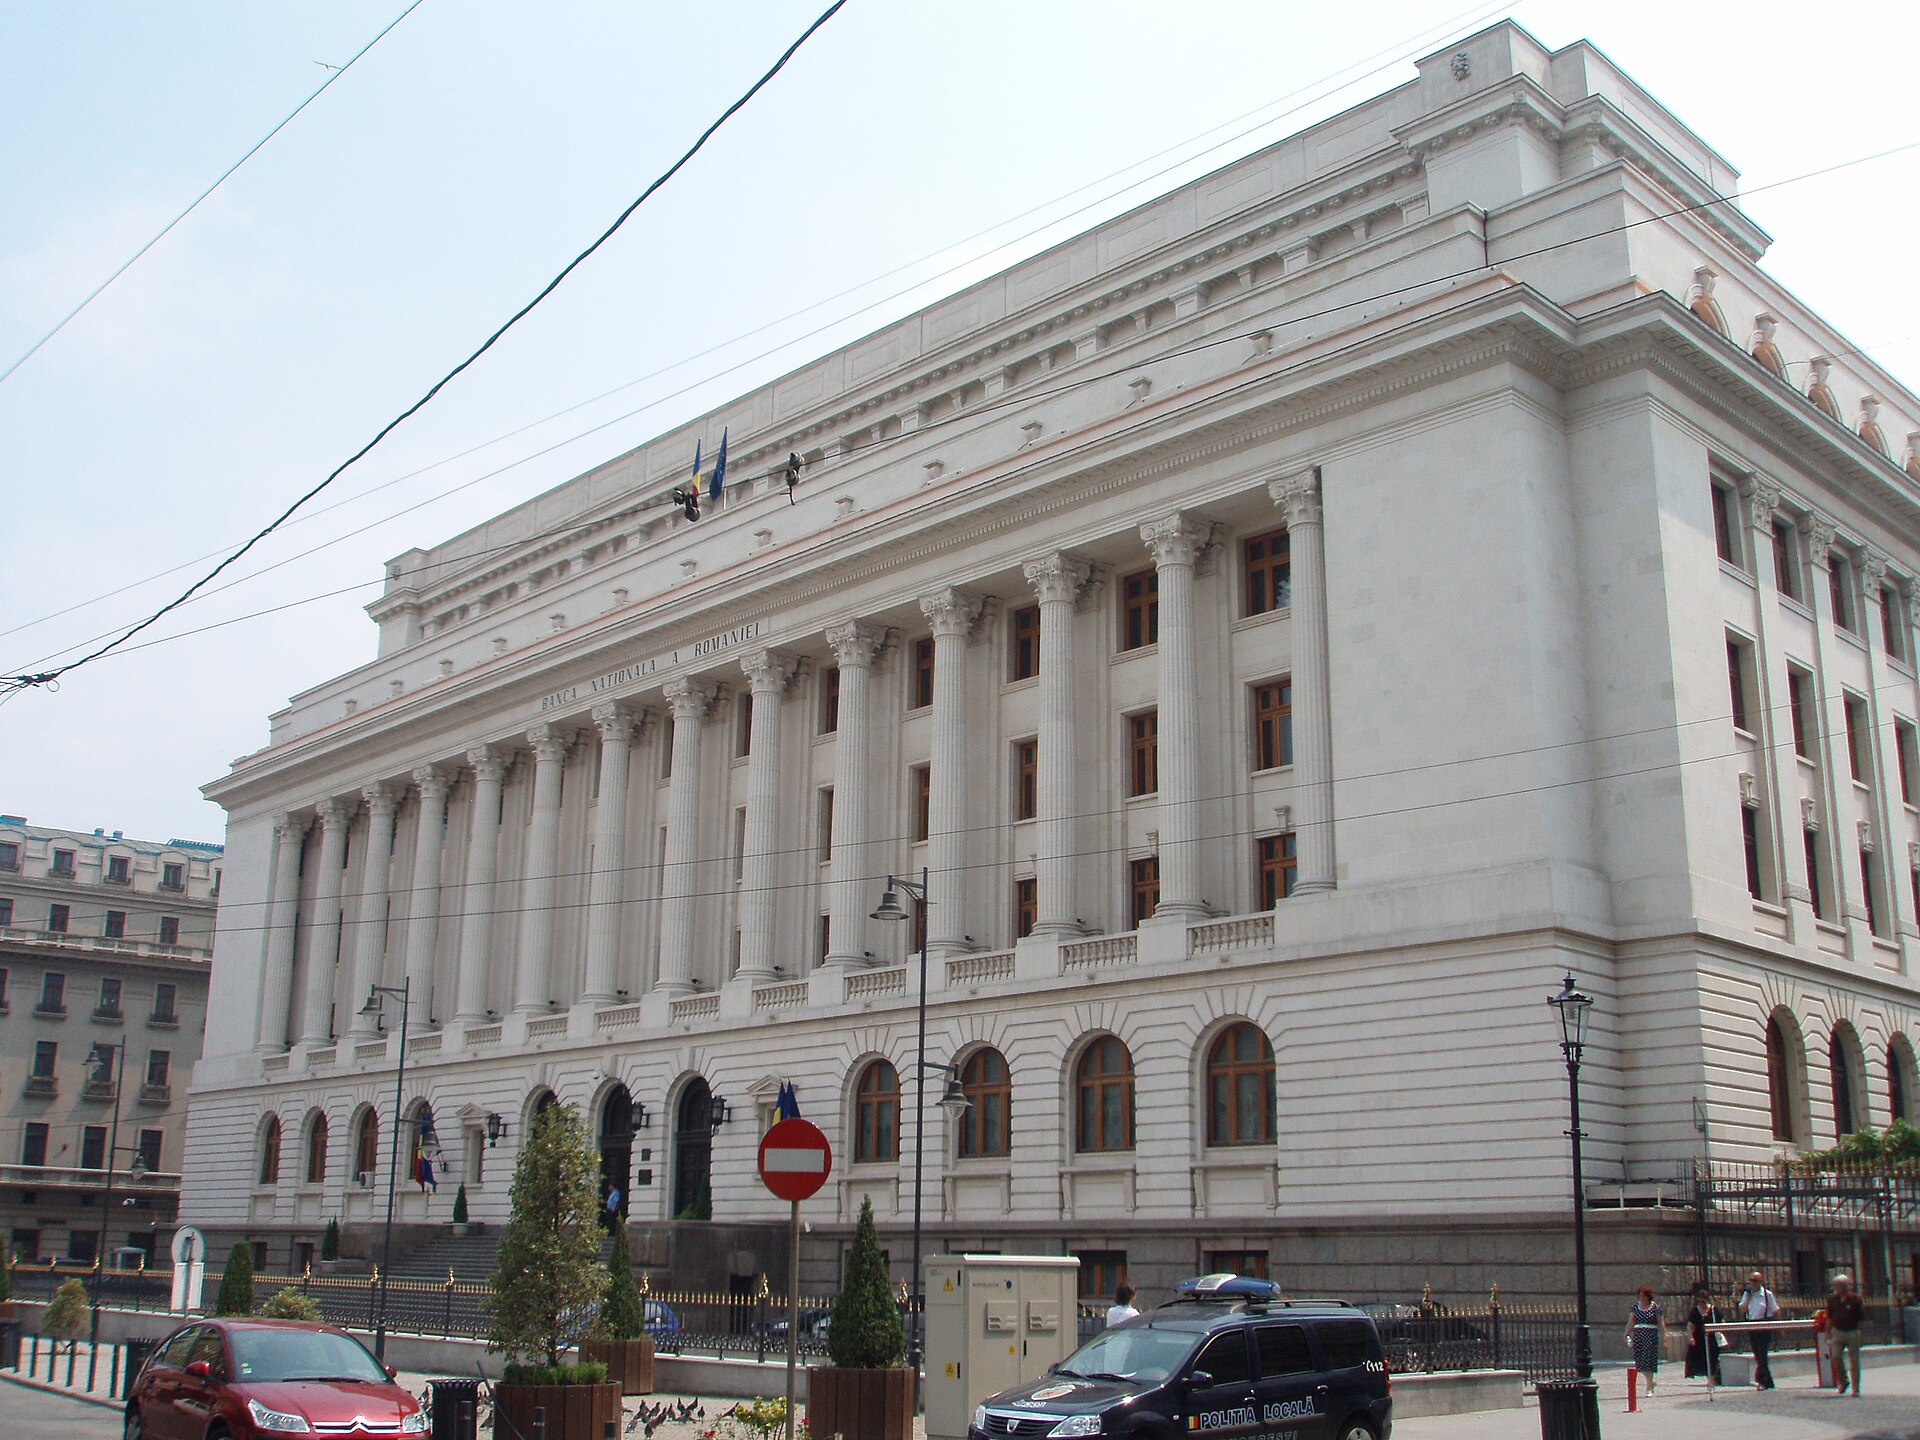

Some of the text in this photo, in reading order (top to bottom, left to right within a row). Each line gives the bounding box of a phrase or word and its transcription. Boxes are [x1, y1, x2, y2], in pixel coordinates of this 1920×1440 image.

[541, 622, 760, 710] BANCA NATIONALA A ROMANIEI
[1370, 1361, 1384, 1372] 112
